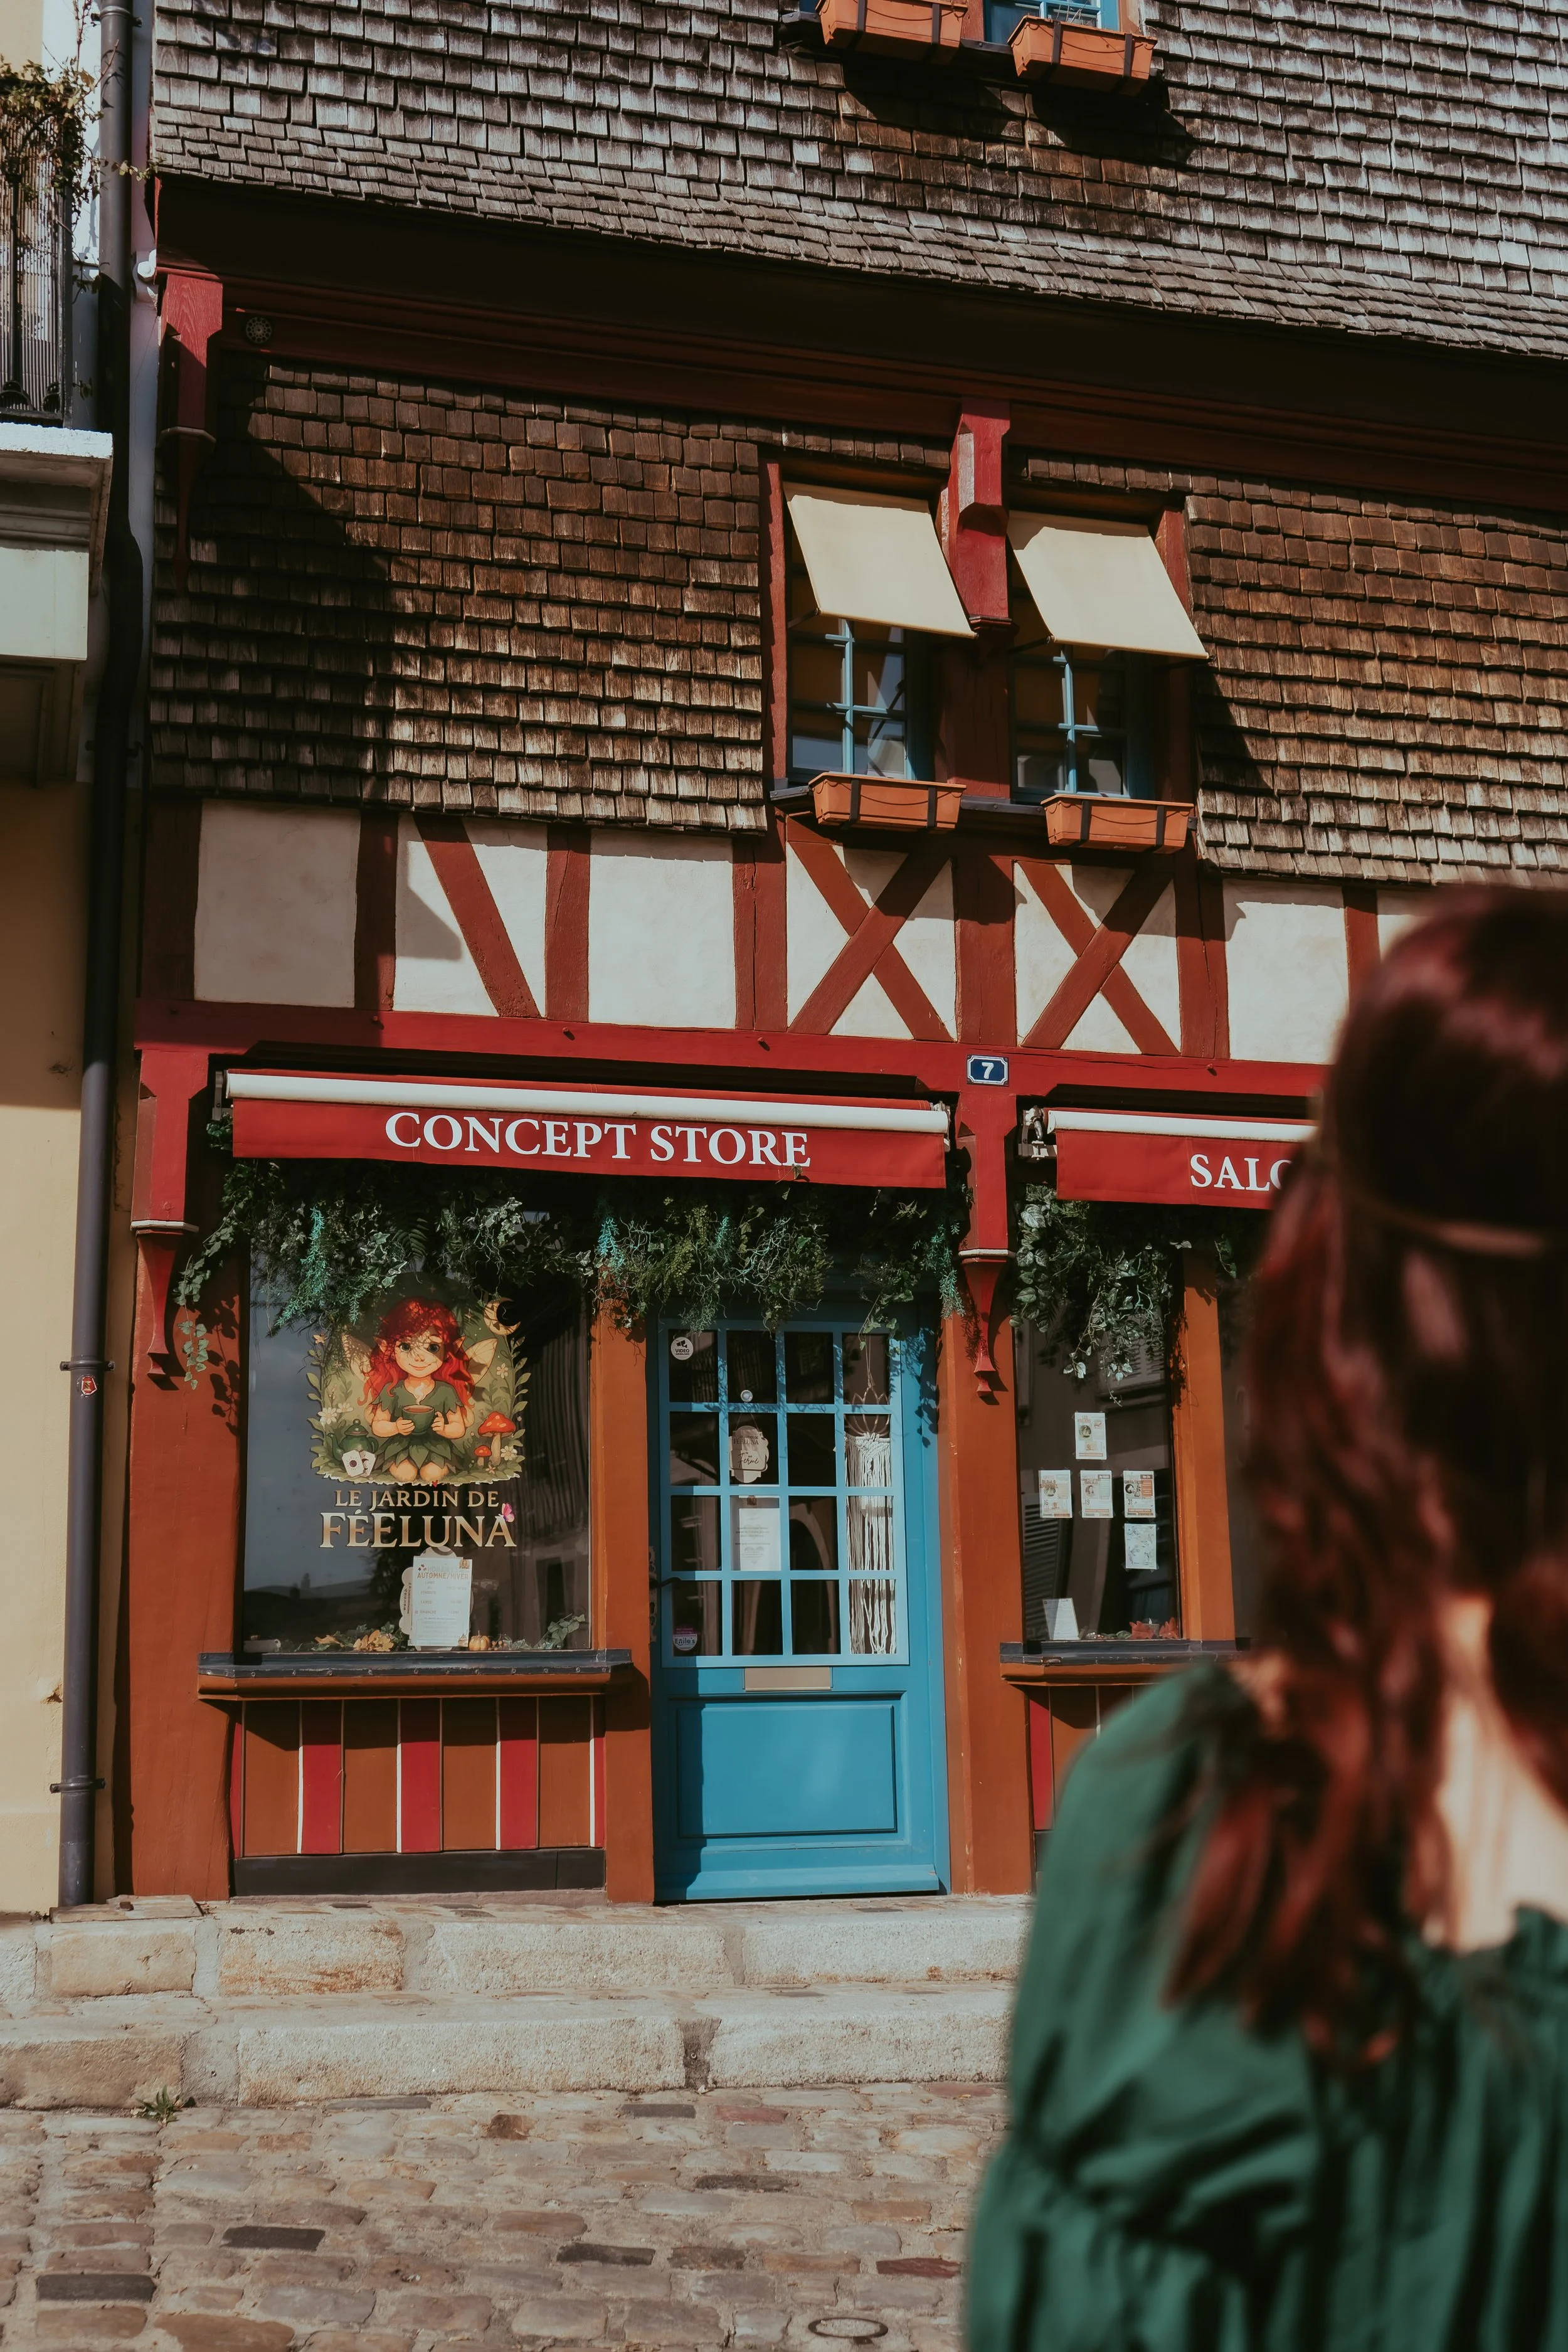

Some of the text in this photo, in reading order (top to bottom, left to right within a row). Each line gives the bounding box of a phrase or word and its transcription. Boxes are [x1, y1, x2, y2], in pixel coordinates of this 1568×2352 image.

[982, 1062, 994, 1079] 7
[385, 1111, 811, 1167] CONCEPT STORE
[335, 1490, 499, 1512] LE JARDIN DE
[319, 1509, 517, 1549] FÉELUNA
[416, 1572, 469, 1580] AUTOMNE/HIVER
